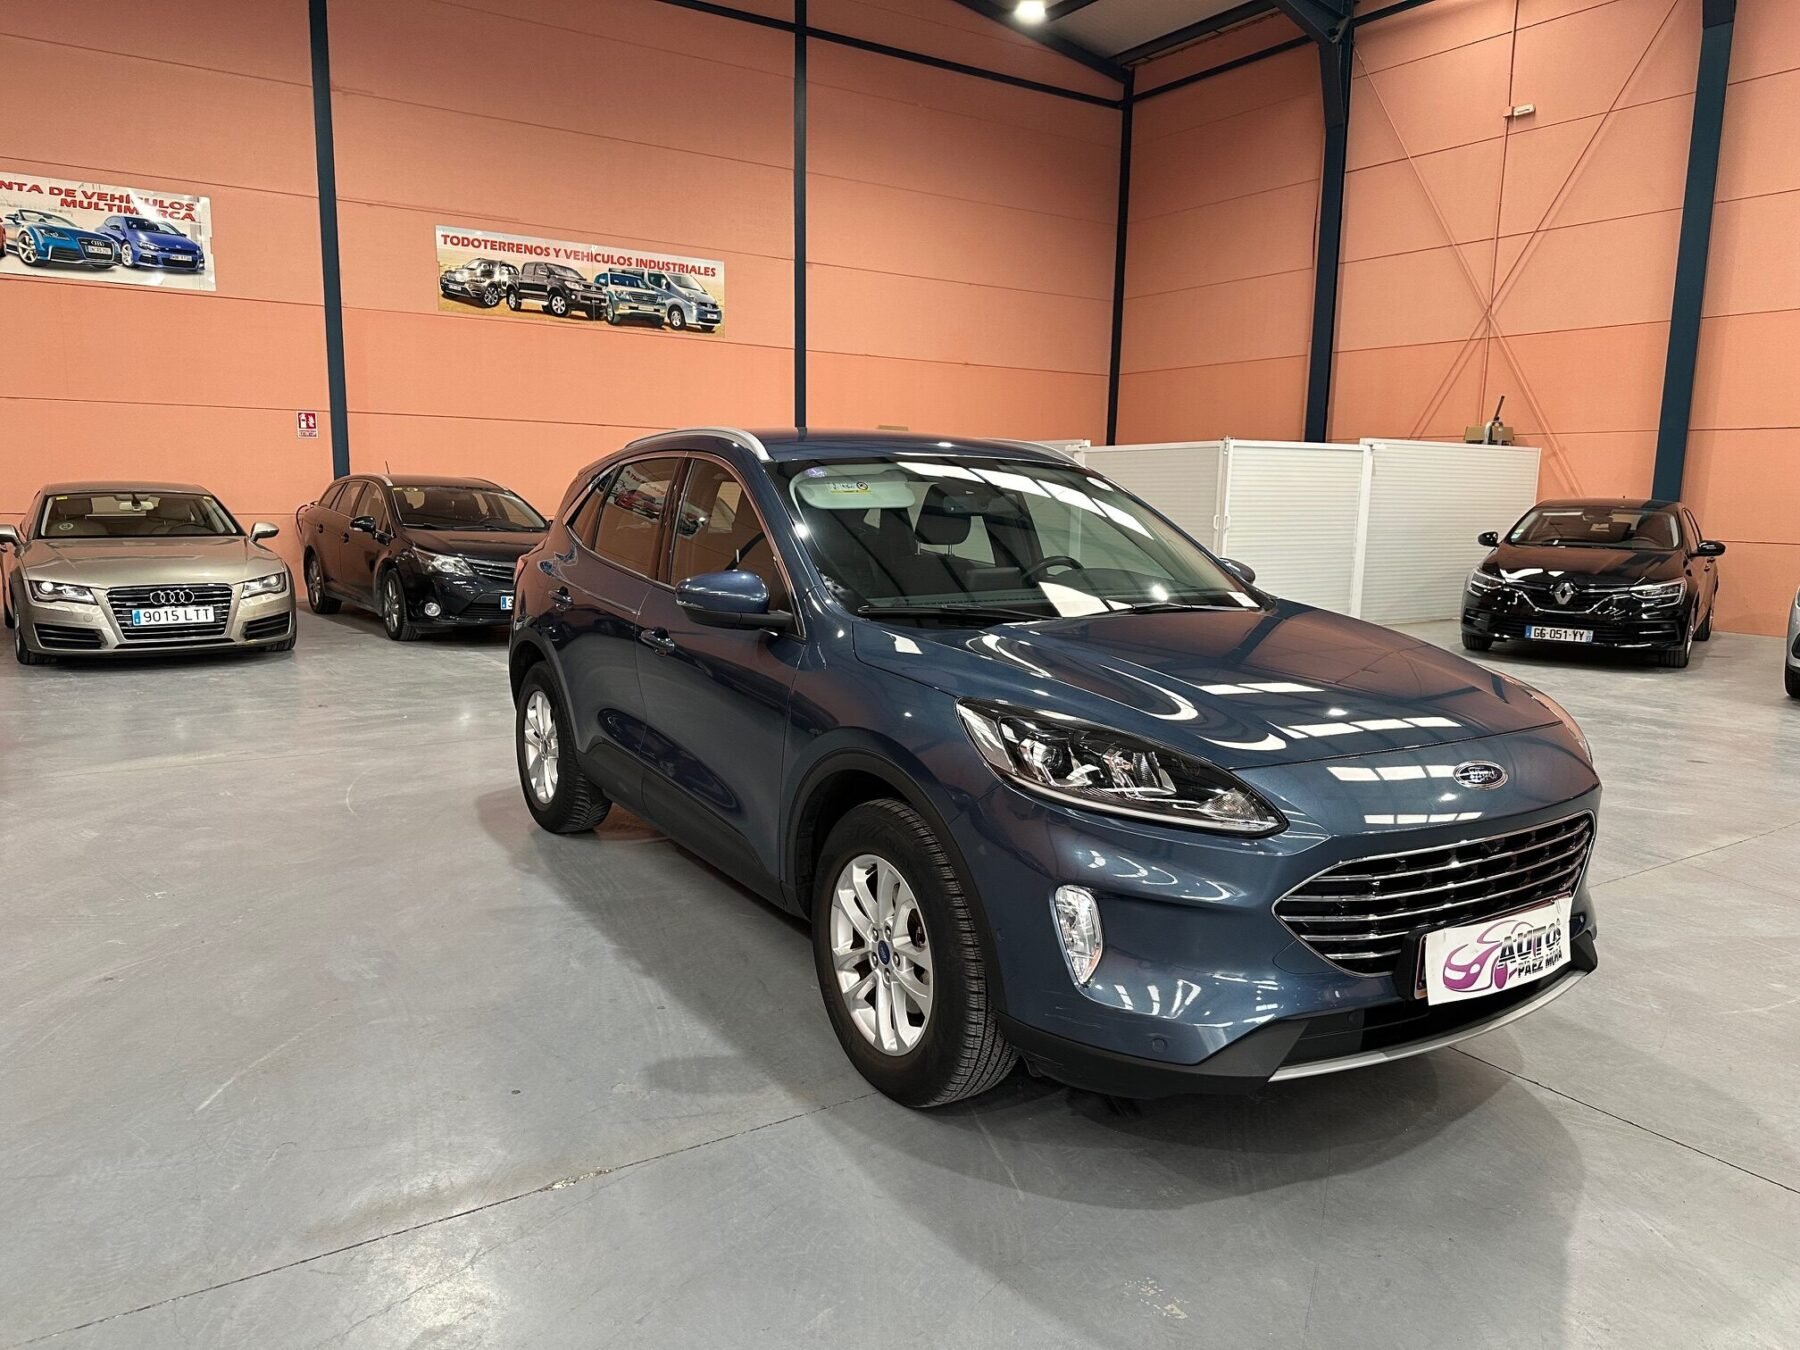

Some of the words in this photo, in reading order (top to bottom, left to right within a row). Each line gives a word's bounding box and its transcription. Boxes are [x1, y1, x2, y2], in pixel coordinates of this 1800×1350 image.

[49, 186, 76, 198] DE
[60, 197, 196, 222] MULTIMRCA
[441, 234, 551, 258] TODOTERRENOS
[554, 249, 561, 259] Y
[635, 258, 717, 278] INDUSTRIALES
[143, 609, 180, 623] 9015
[184, 608, 210, 622] LTT
